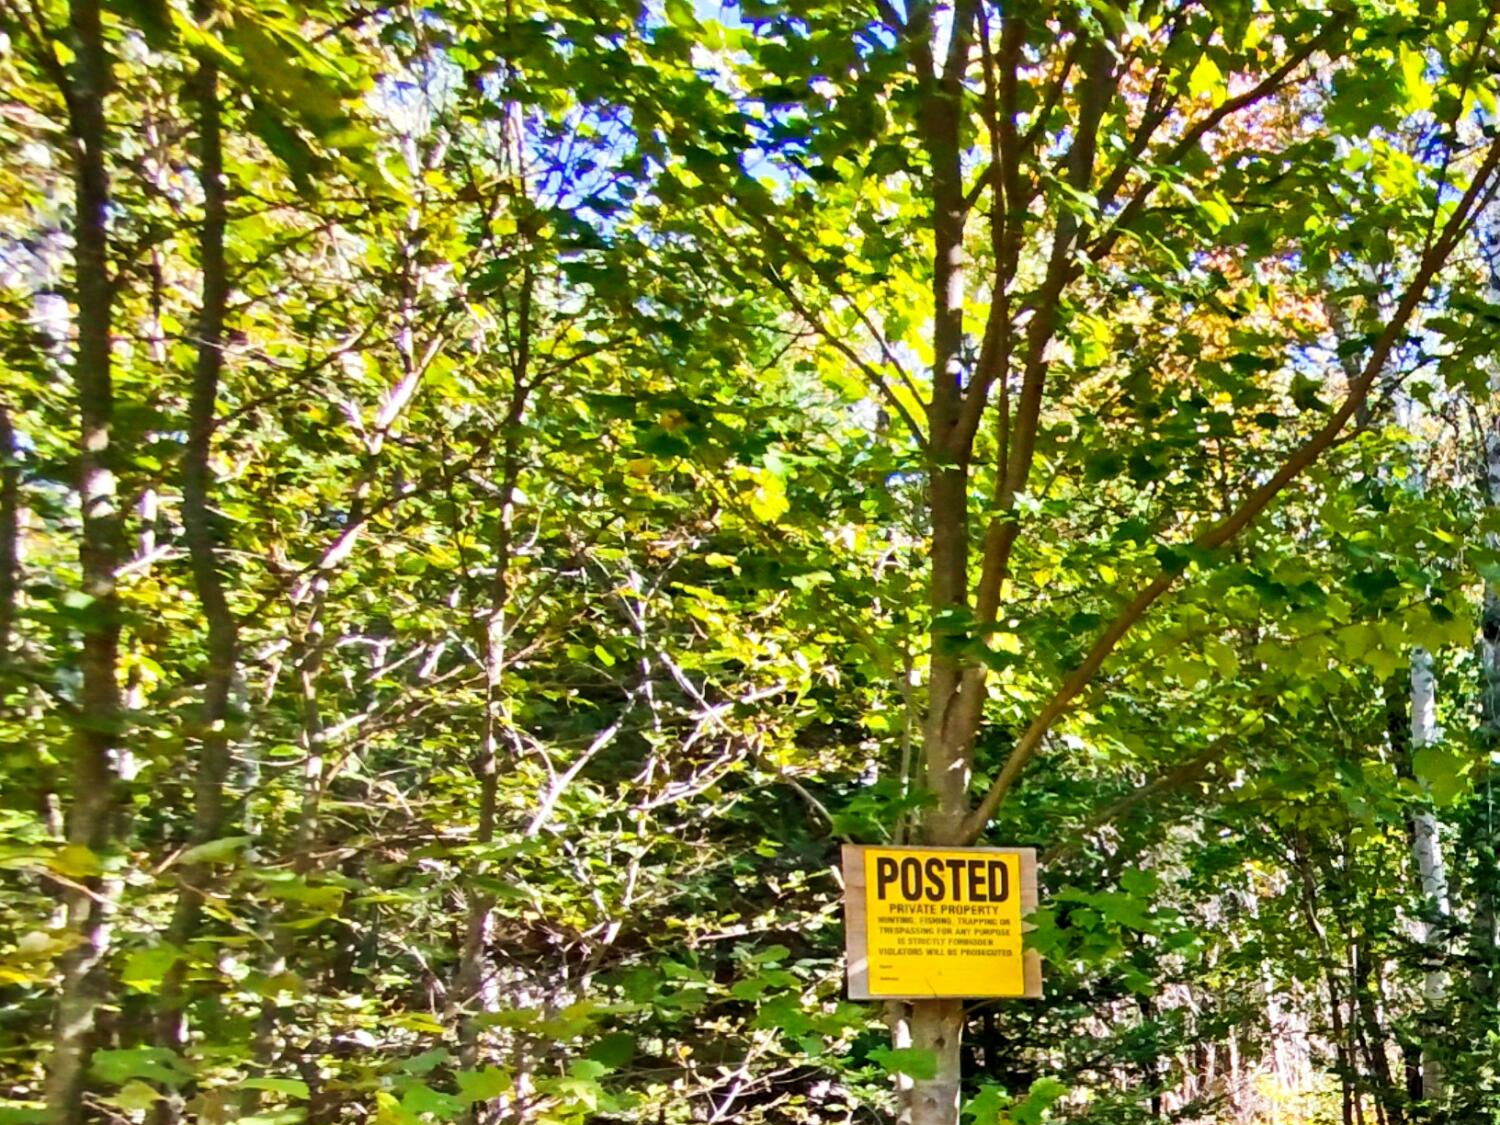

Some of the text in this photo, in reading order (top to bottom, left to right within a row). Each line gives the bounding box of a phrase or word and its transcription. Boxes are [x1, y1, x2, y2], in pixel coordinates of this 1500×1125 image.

[877, 857, 1009, 902] POSTED
[889, 904, 999, 915] PRIVATE PROPERTY
[880, 927, 933, 935] TRESPASSING
